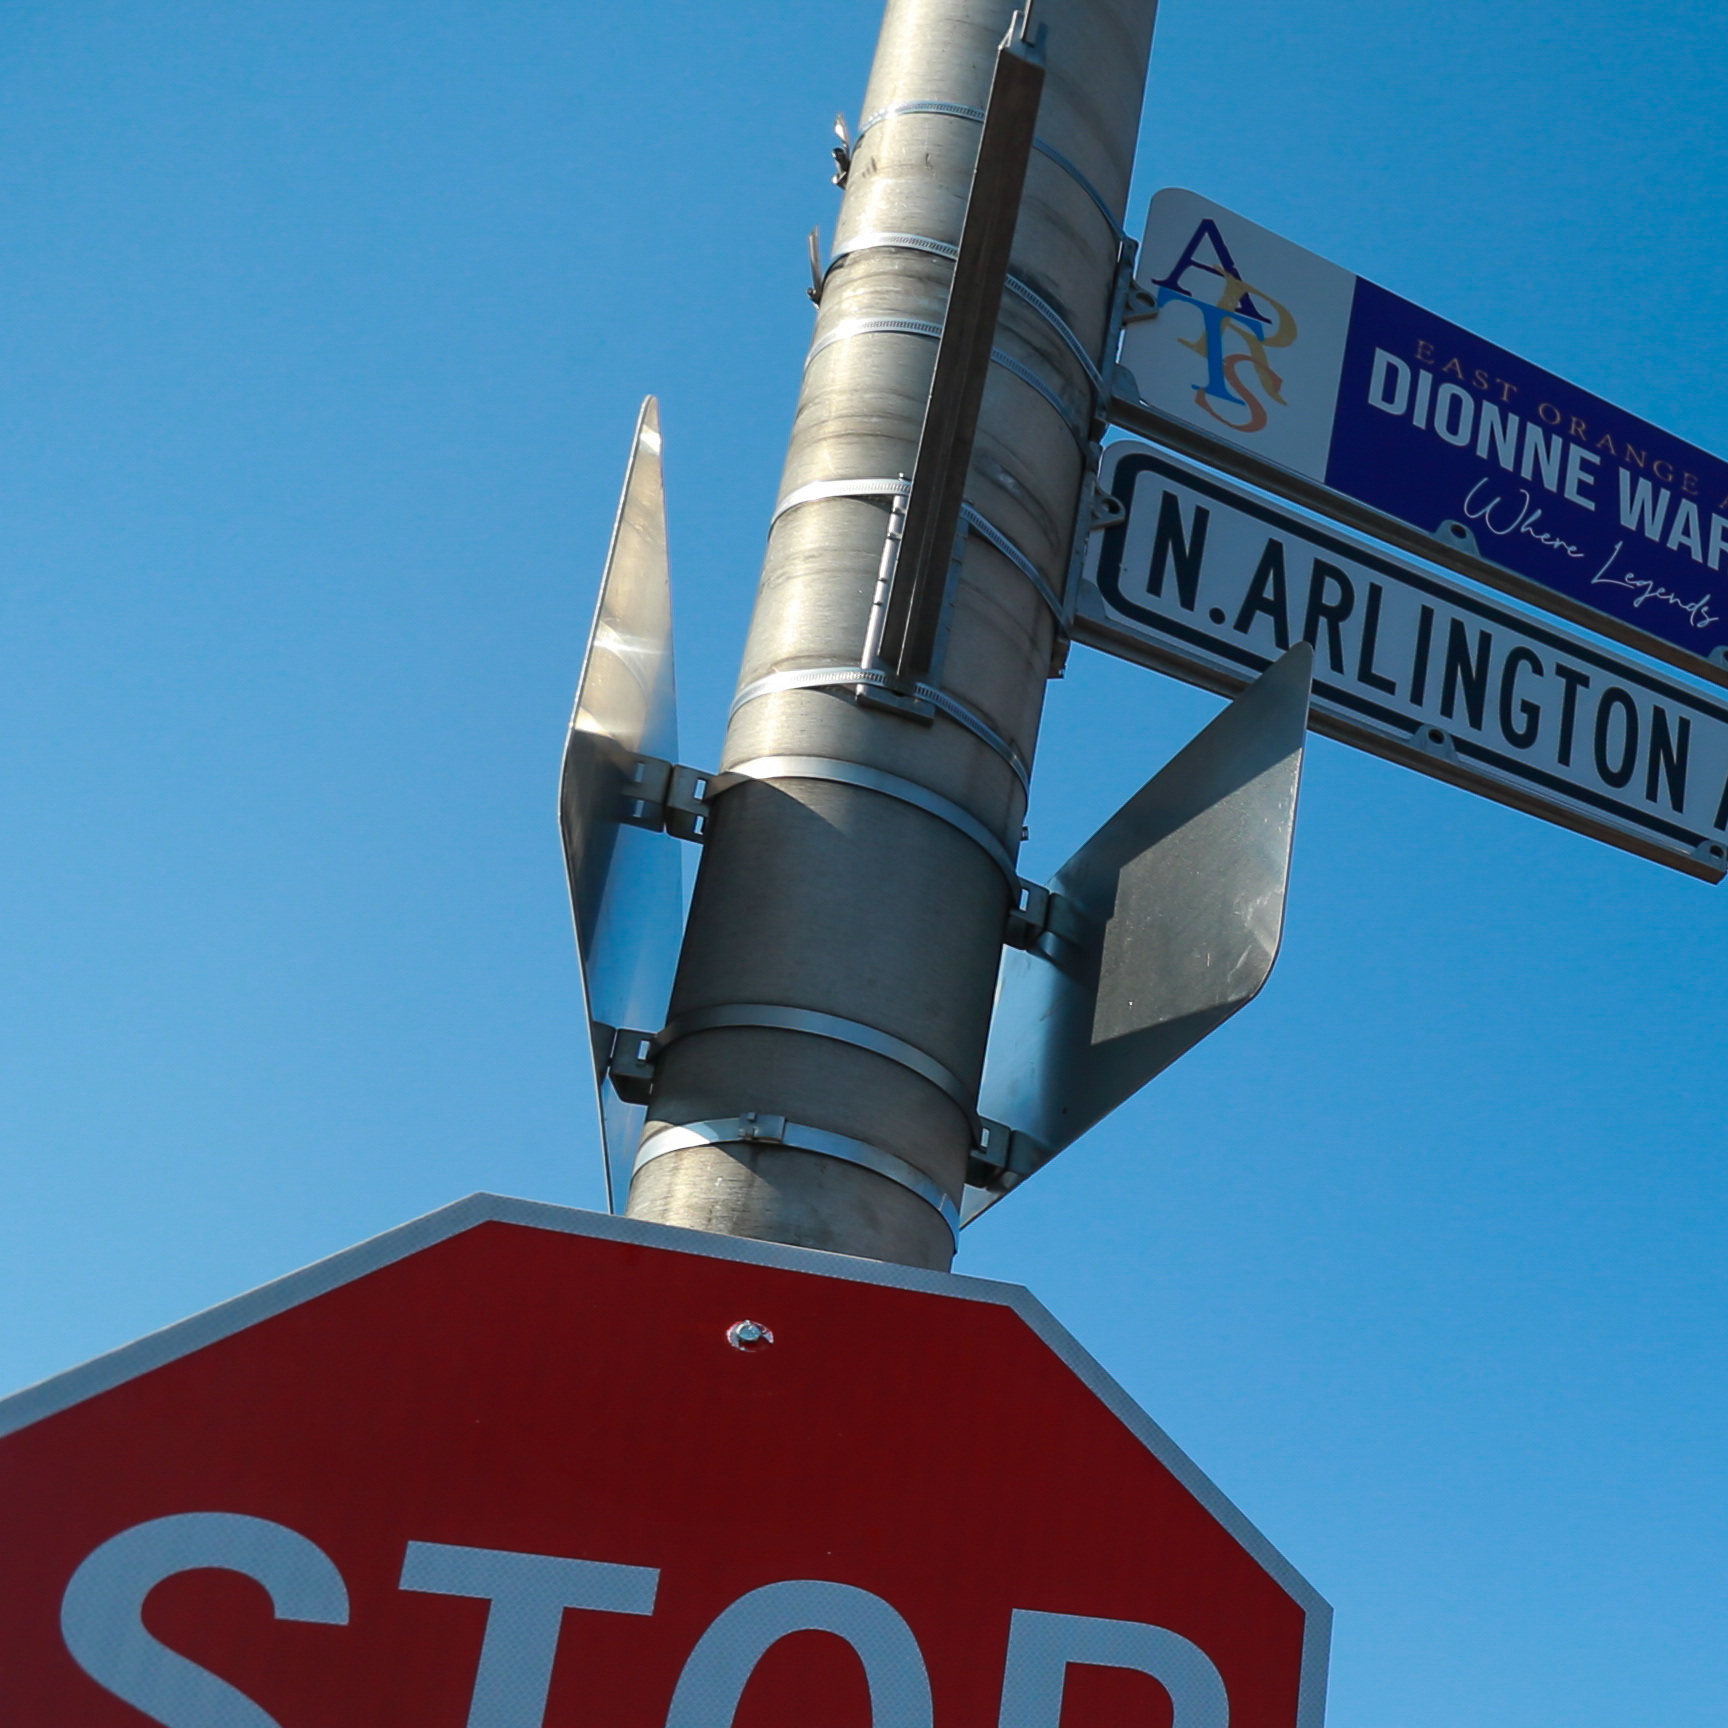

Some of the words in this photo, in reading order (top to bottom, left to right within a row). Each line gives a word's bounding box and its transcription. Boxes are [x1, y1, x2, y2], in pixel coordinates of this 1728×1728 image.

[1367, 346, 1602, 512] DIONNE
[1413, 338, 1520, 404] EAST
[1536, 402, 1702, 497] ORANGE
[1463, 473, 1585, 563] Where
[1589, 539, 1719, 630] Legends
